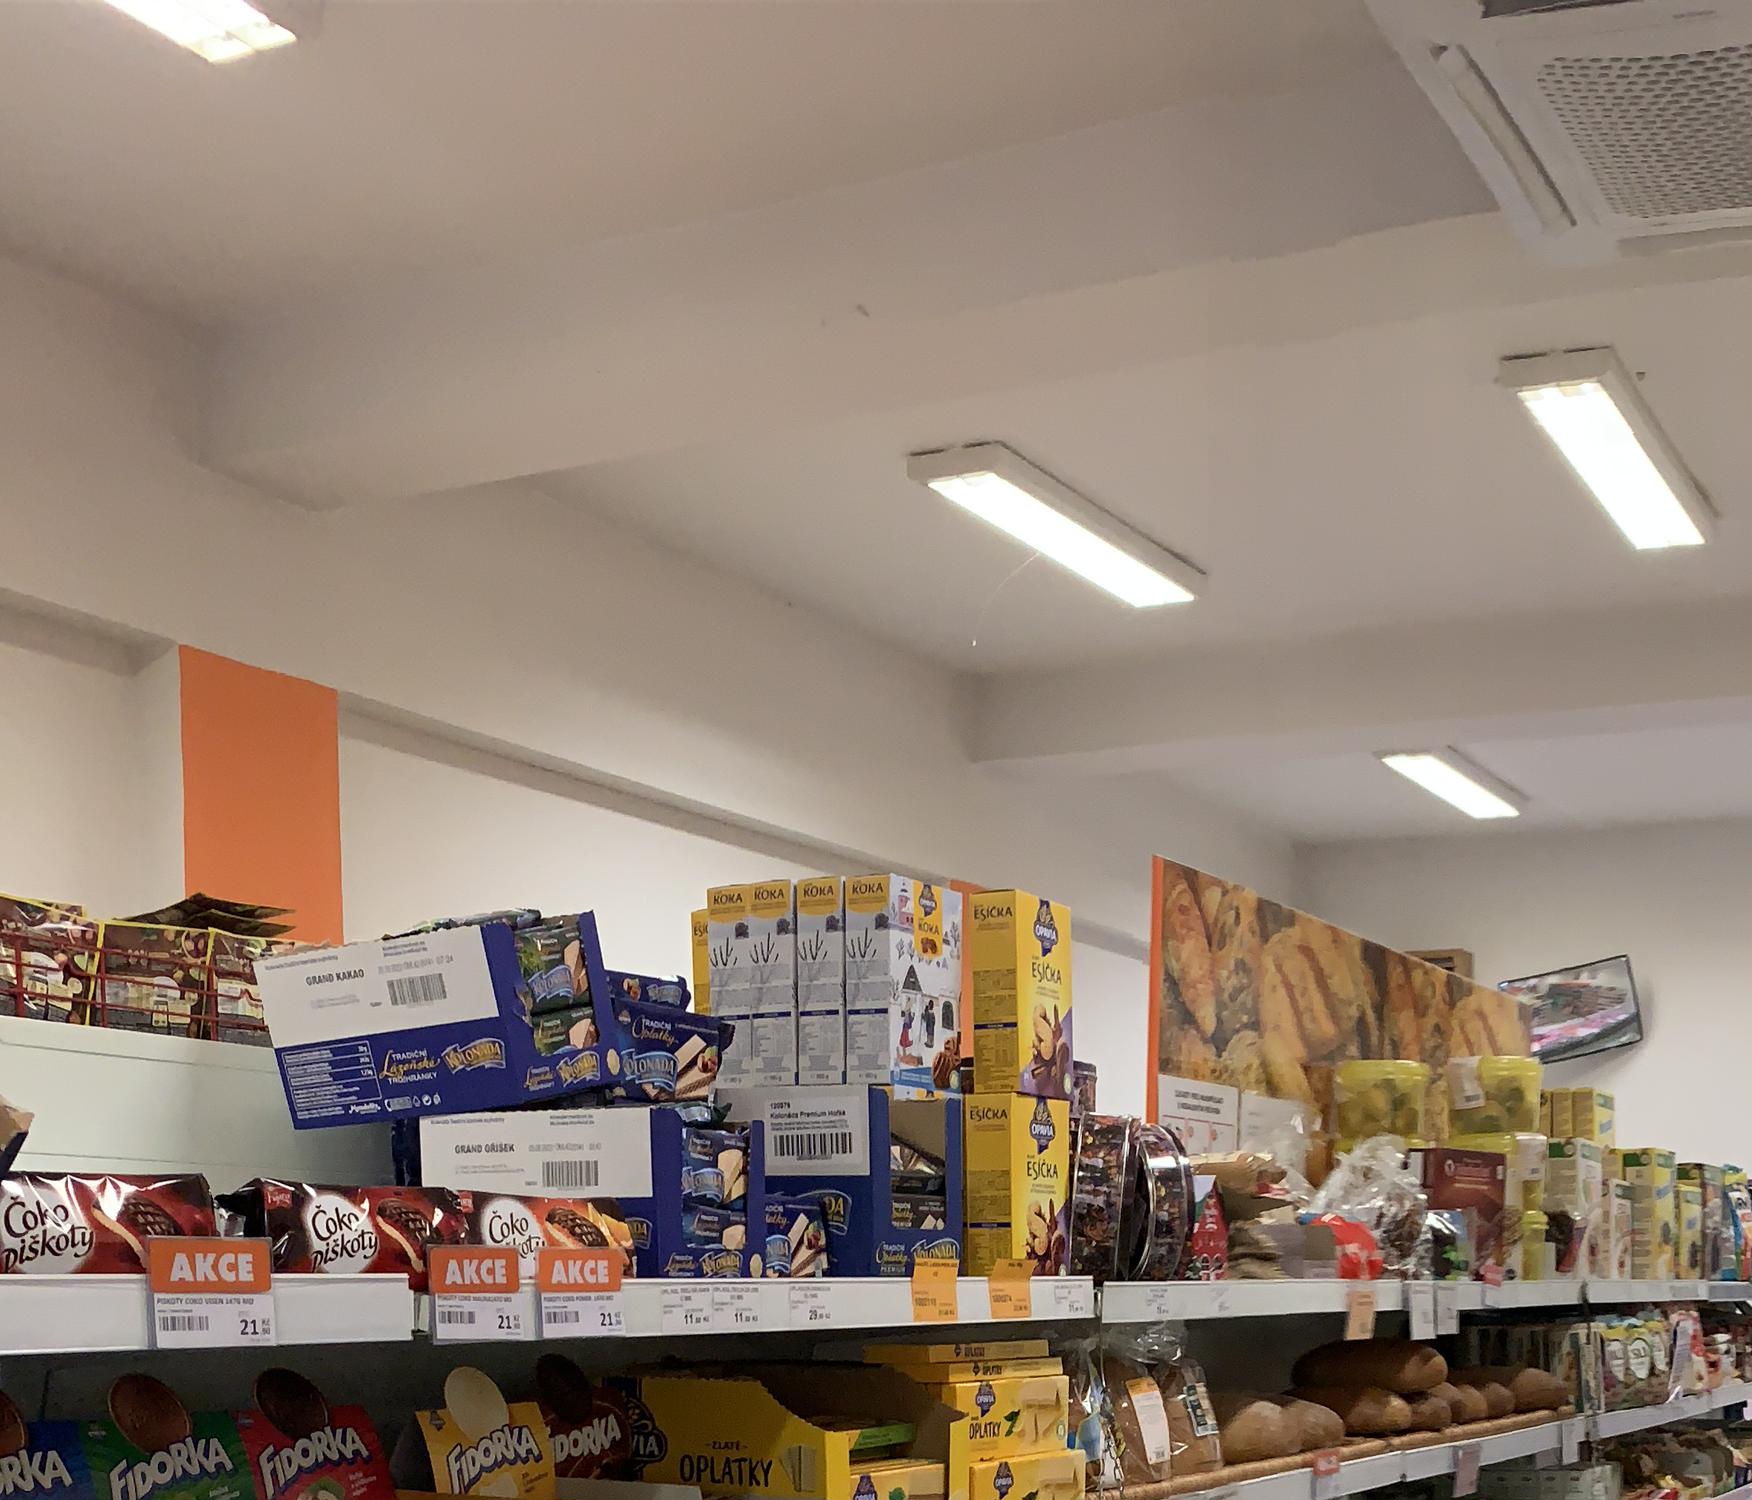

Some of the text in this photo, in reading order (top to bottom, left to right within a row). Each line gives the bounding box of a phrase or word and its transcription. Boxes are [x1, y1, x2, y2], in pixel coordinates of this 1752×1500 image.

[753, 888, 785, 901] KOKA
[803, 885, 834, 898] KOKA
[851, 882, 884, 896] KOKA
[4, 1195, 69, 1238] Čoko
[311, 1204, 361, 1242] Čoko
[488, 1209, 529, 1245] Čoko
[169, 1252, 255, 1283] AKCE
[445, 1258, 508, 1286] AKCE
[551, 1258, 610, 1285] AKCE
[239, 1318, 259, 1337] 21
[497, 1313, 512, 1331] 21
[599, 1311, 614, 1328] 21
[257, 1425, 370, 1500] FIDORKA
[447, 1425, 542, 1496] FIDORKA
[678, 1453, 773, 1488] OPLATKY
